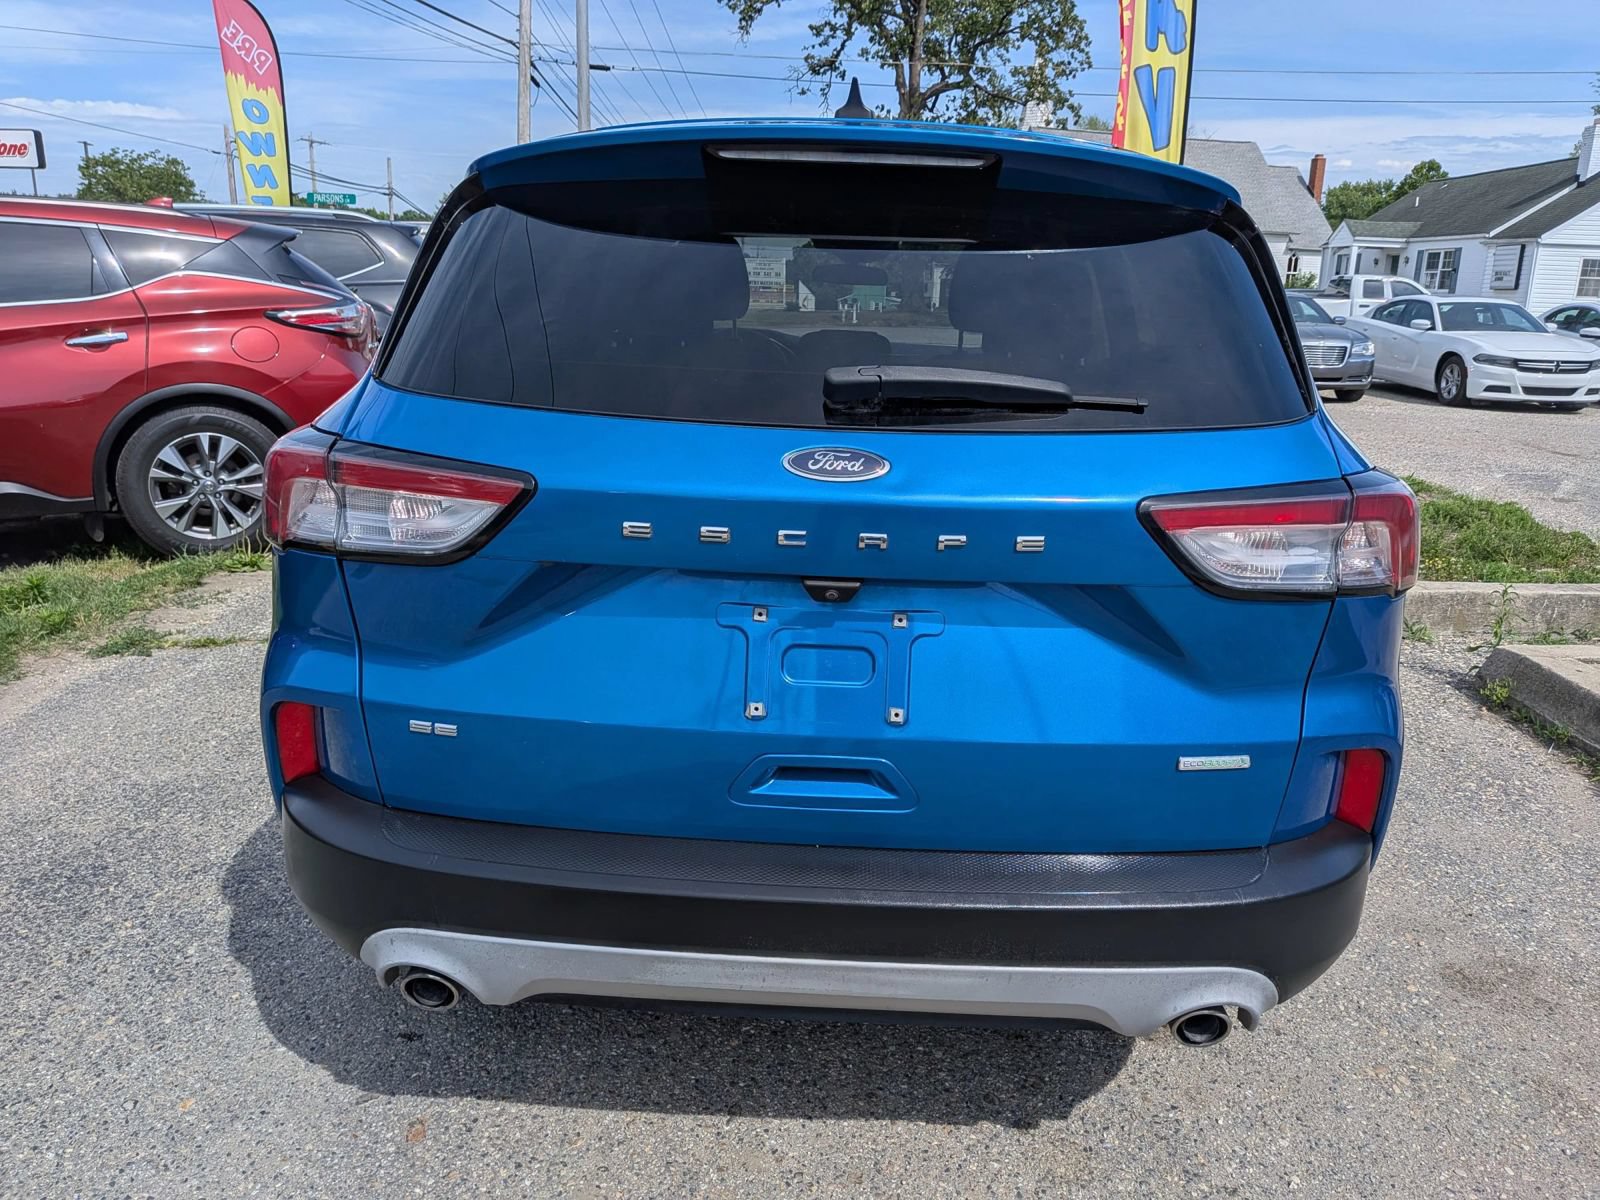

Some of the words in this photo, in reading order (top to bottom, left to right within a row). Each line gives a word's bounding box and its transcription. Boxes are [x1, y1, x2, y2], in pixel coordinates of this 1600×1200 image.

[313, 193, 344, 204] PARSONS
[807, 451, 865, 472] Ford
[622, 520, 1046, 553] ESCAPE
[409, 719, 458, 737] SE
